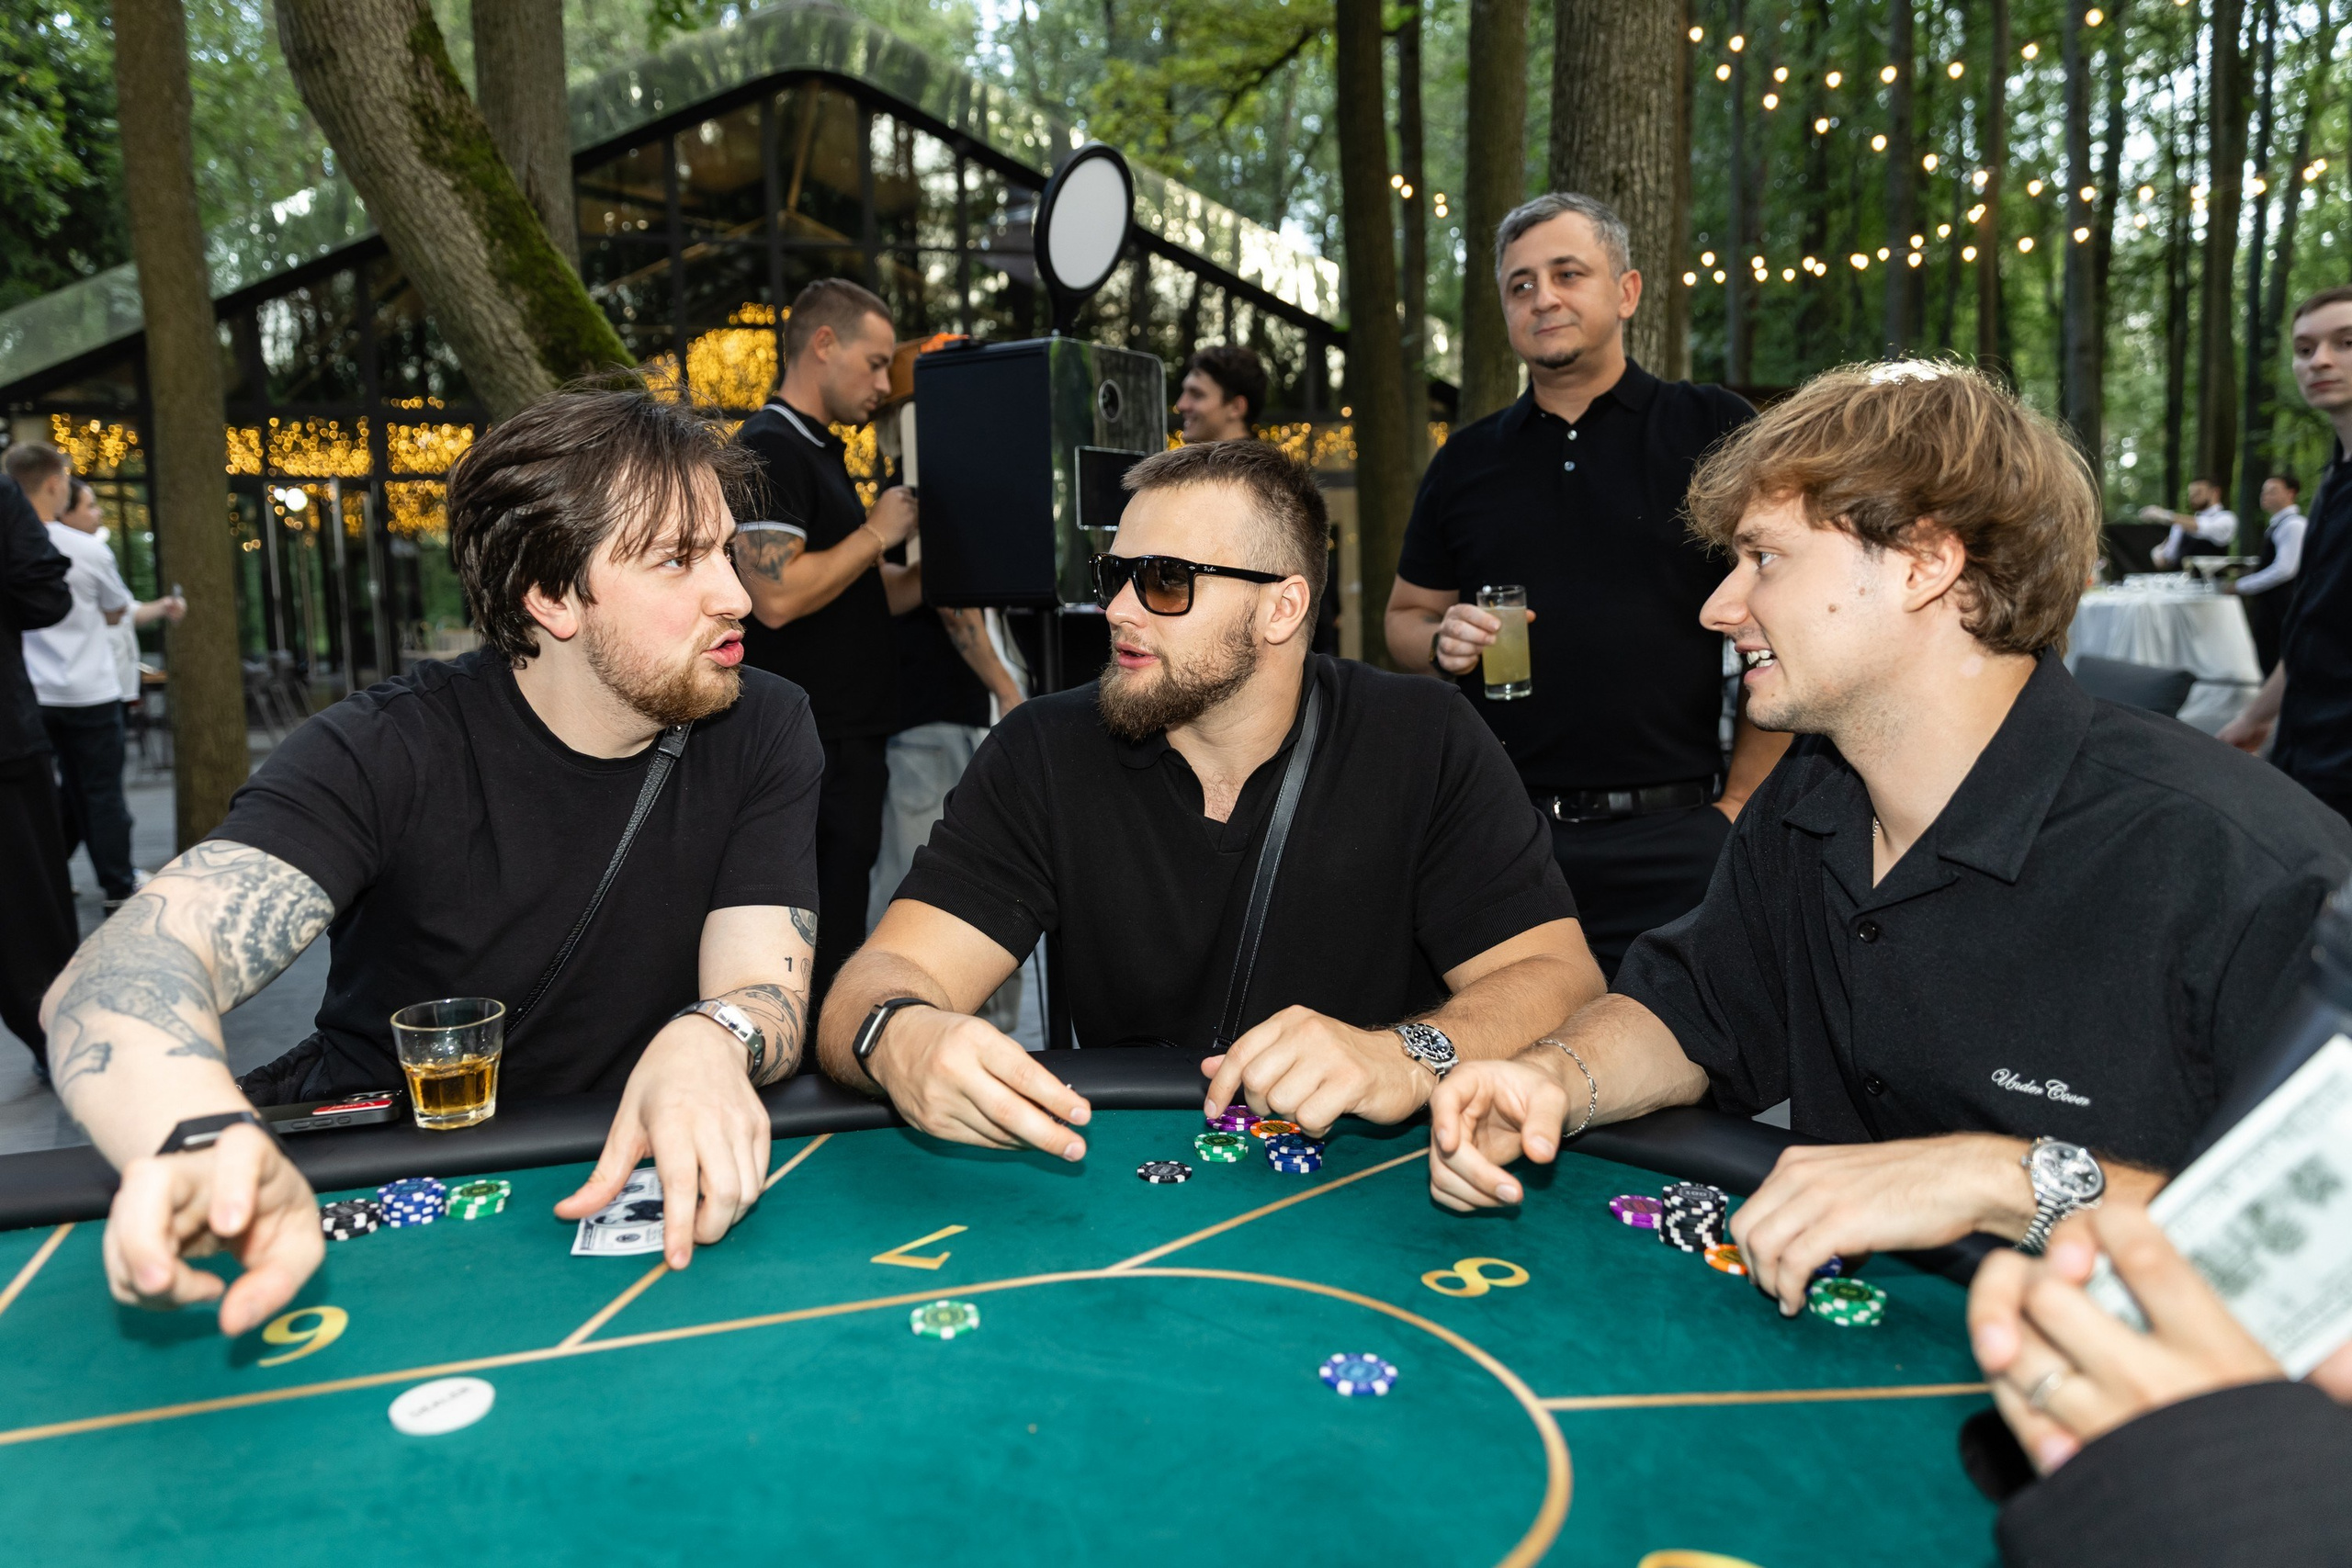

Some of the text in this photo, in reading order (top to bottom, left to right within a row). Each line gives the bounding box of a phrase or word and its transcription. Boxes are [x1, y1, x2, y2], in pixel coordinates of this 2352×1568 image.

[1991, 1067, 2091, 1106] Under Cover
[870, 1224, 968, 1269] 7
[1421, 1257, 1530, 1298] 8
